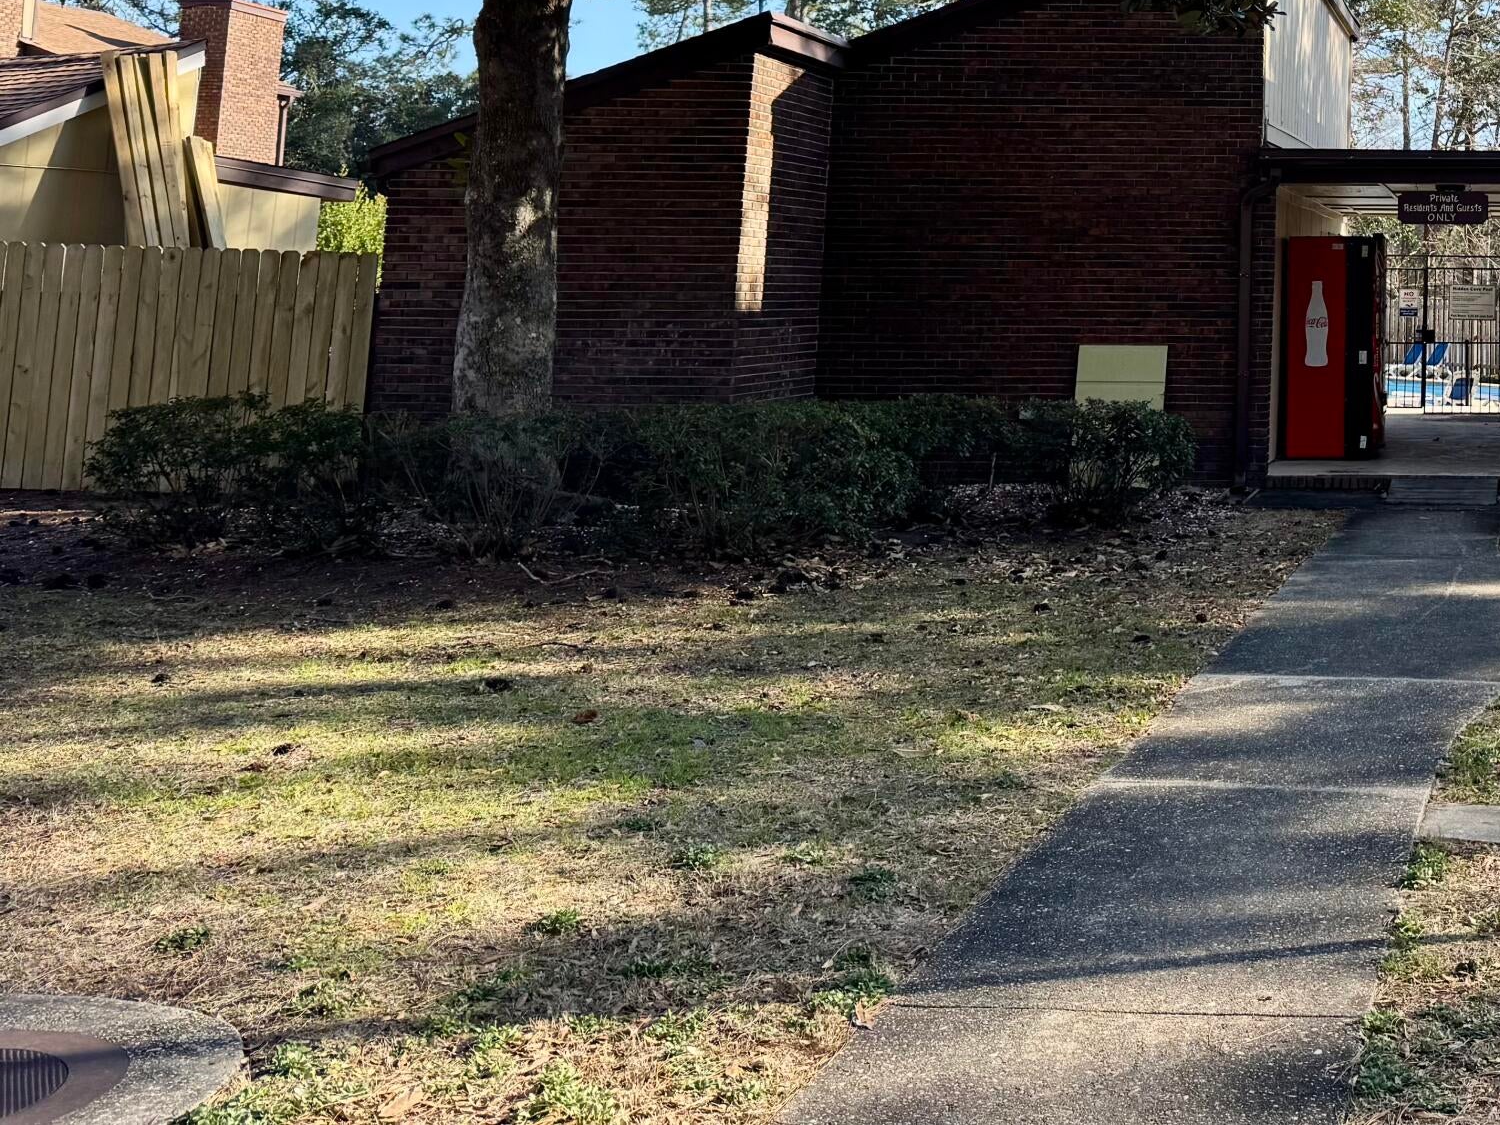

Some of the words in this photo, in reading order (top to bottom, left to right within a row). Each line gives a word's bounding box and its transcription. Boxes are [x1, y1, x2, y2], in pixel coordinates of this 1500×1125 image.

[1429, 193, 1460, 203] Private
[1403, 203, 1438, 212] Residents
[1439, 203, 1455, 212] And
[1457, 203, 1482, 212] Guests
[1427, 213, 1457, 222] ONLY
